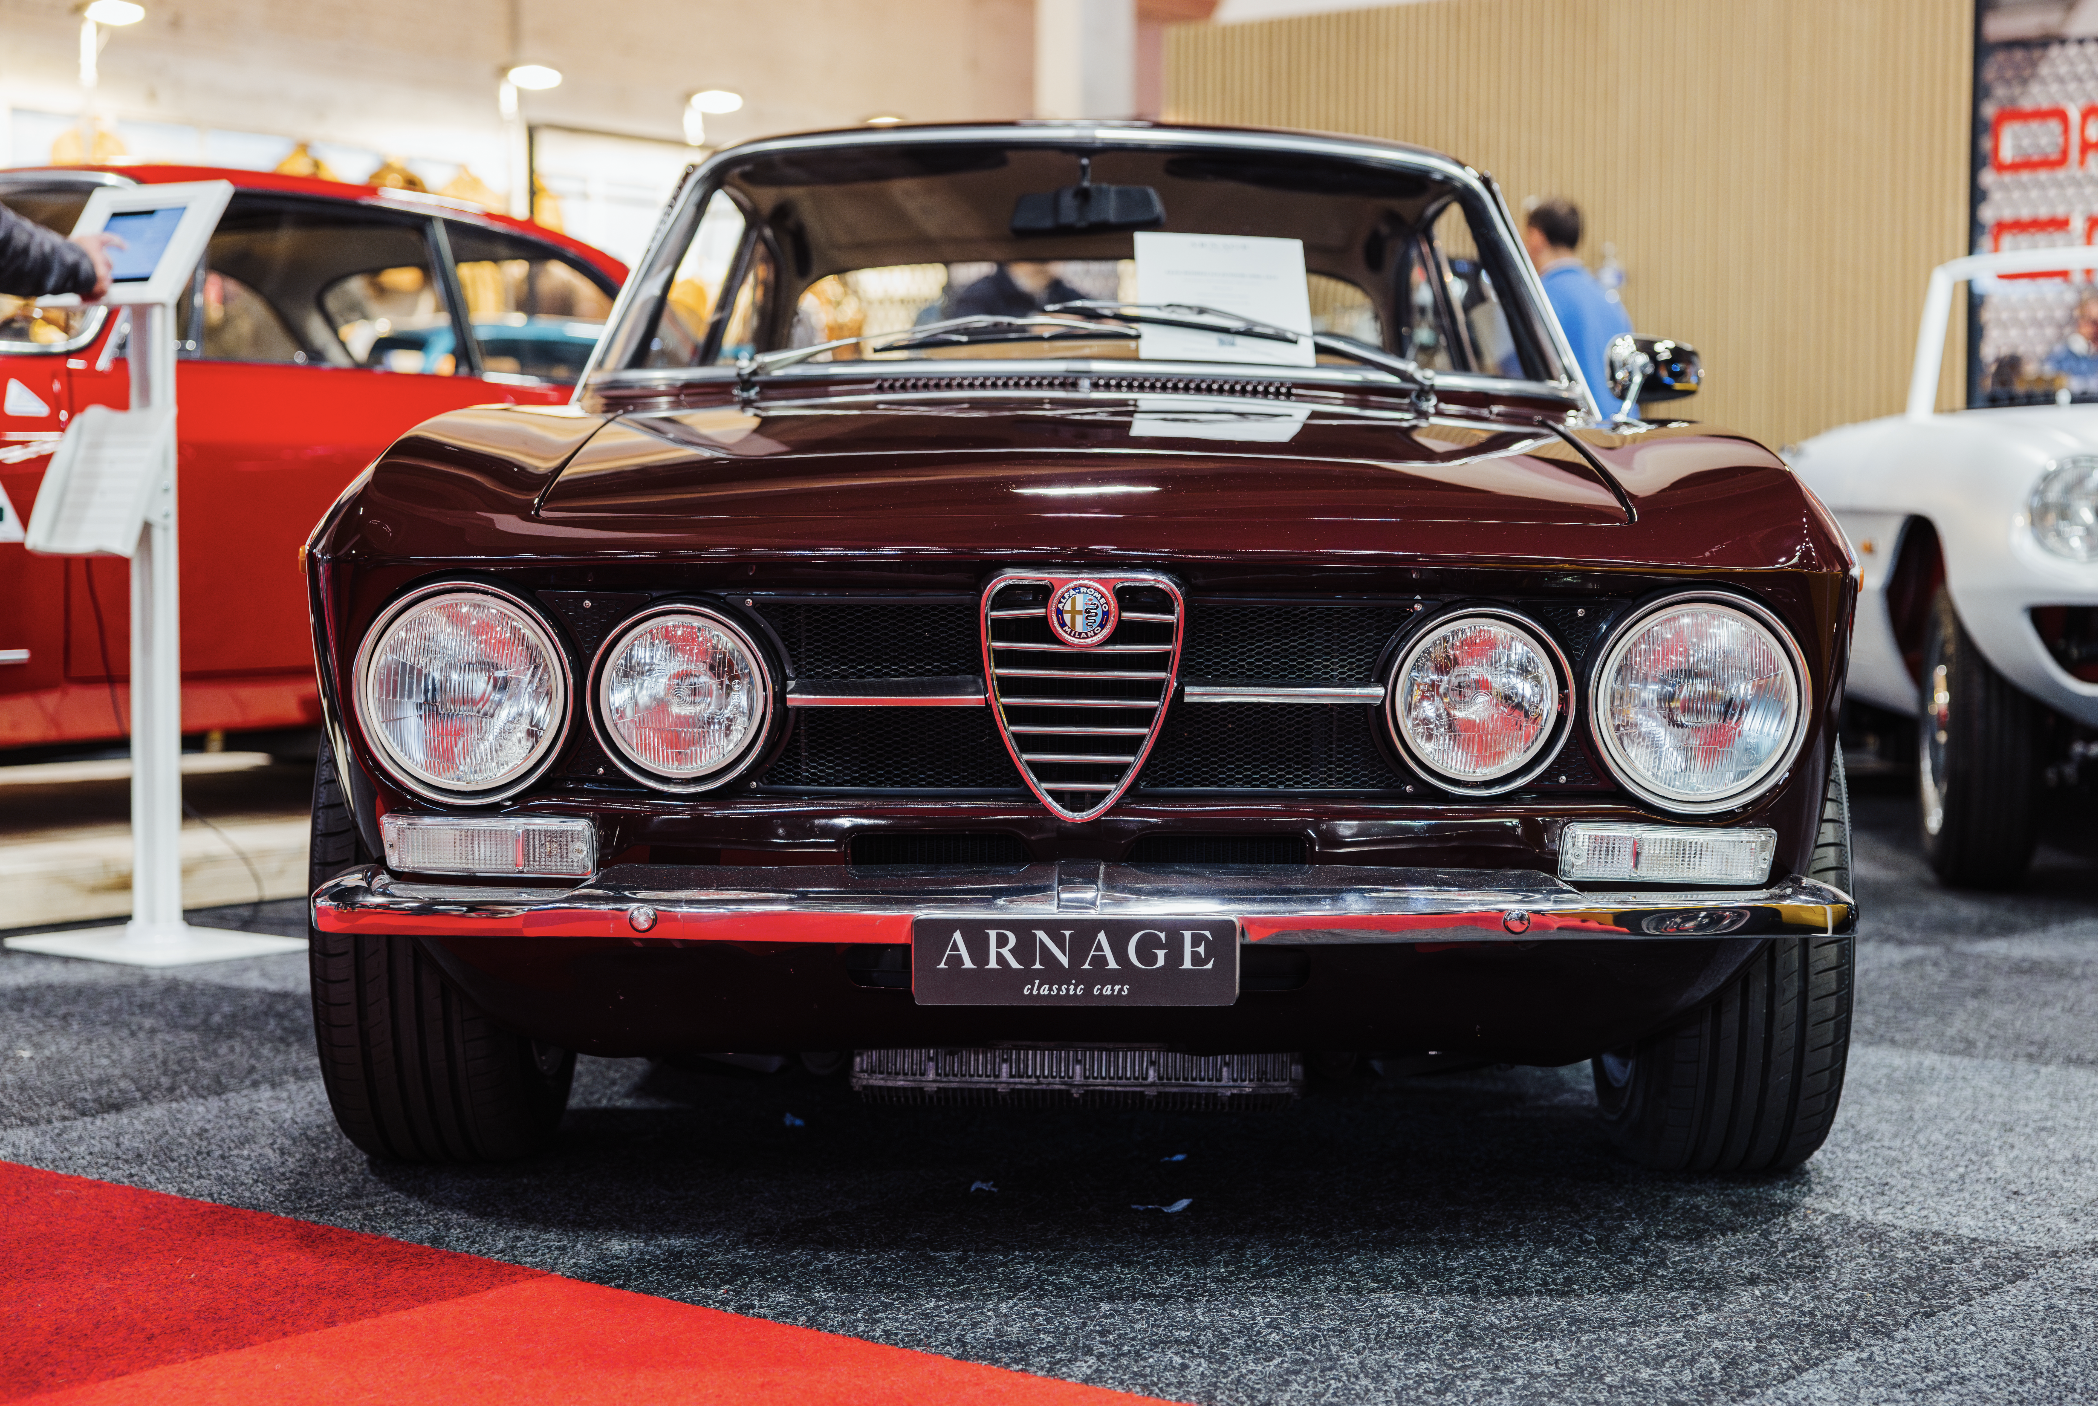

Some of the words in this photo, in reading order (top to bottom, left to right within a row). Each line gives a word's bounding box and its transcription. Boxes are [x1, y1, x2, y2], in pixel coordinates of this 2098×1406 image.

[1062, 626, 1102, 639] MILANO
[936, 929, 1215, 969] ARNAGE
[1023, 980, 1085, 996] classic
[1093, 984, 1130, 996] cars
